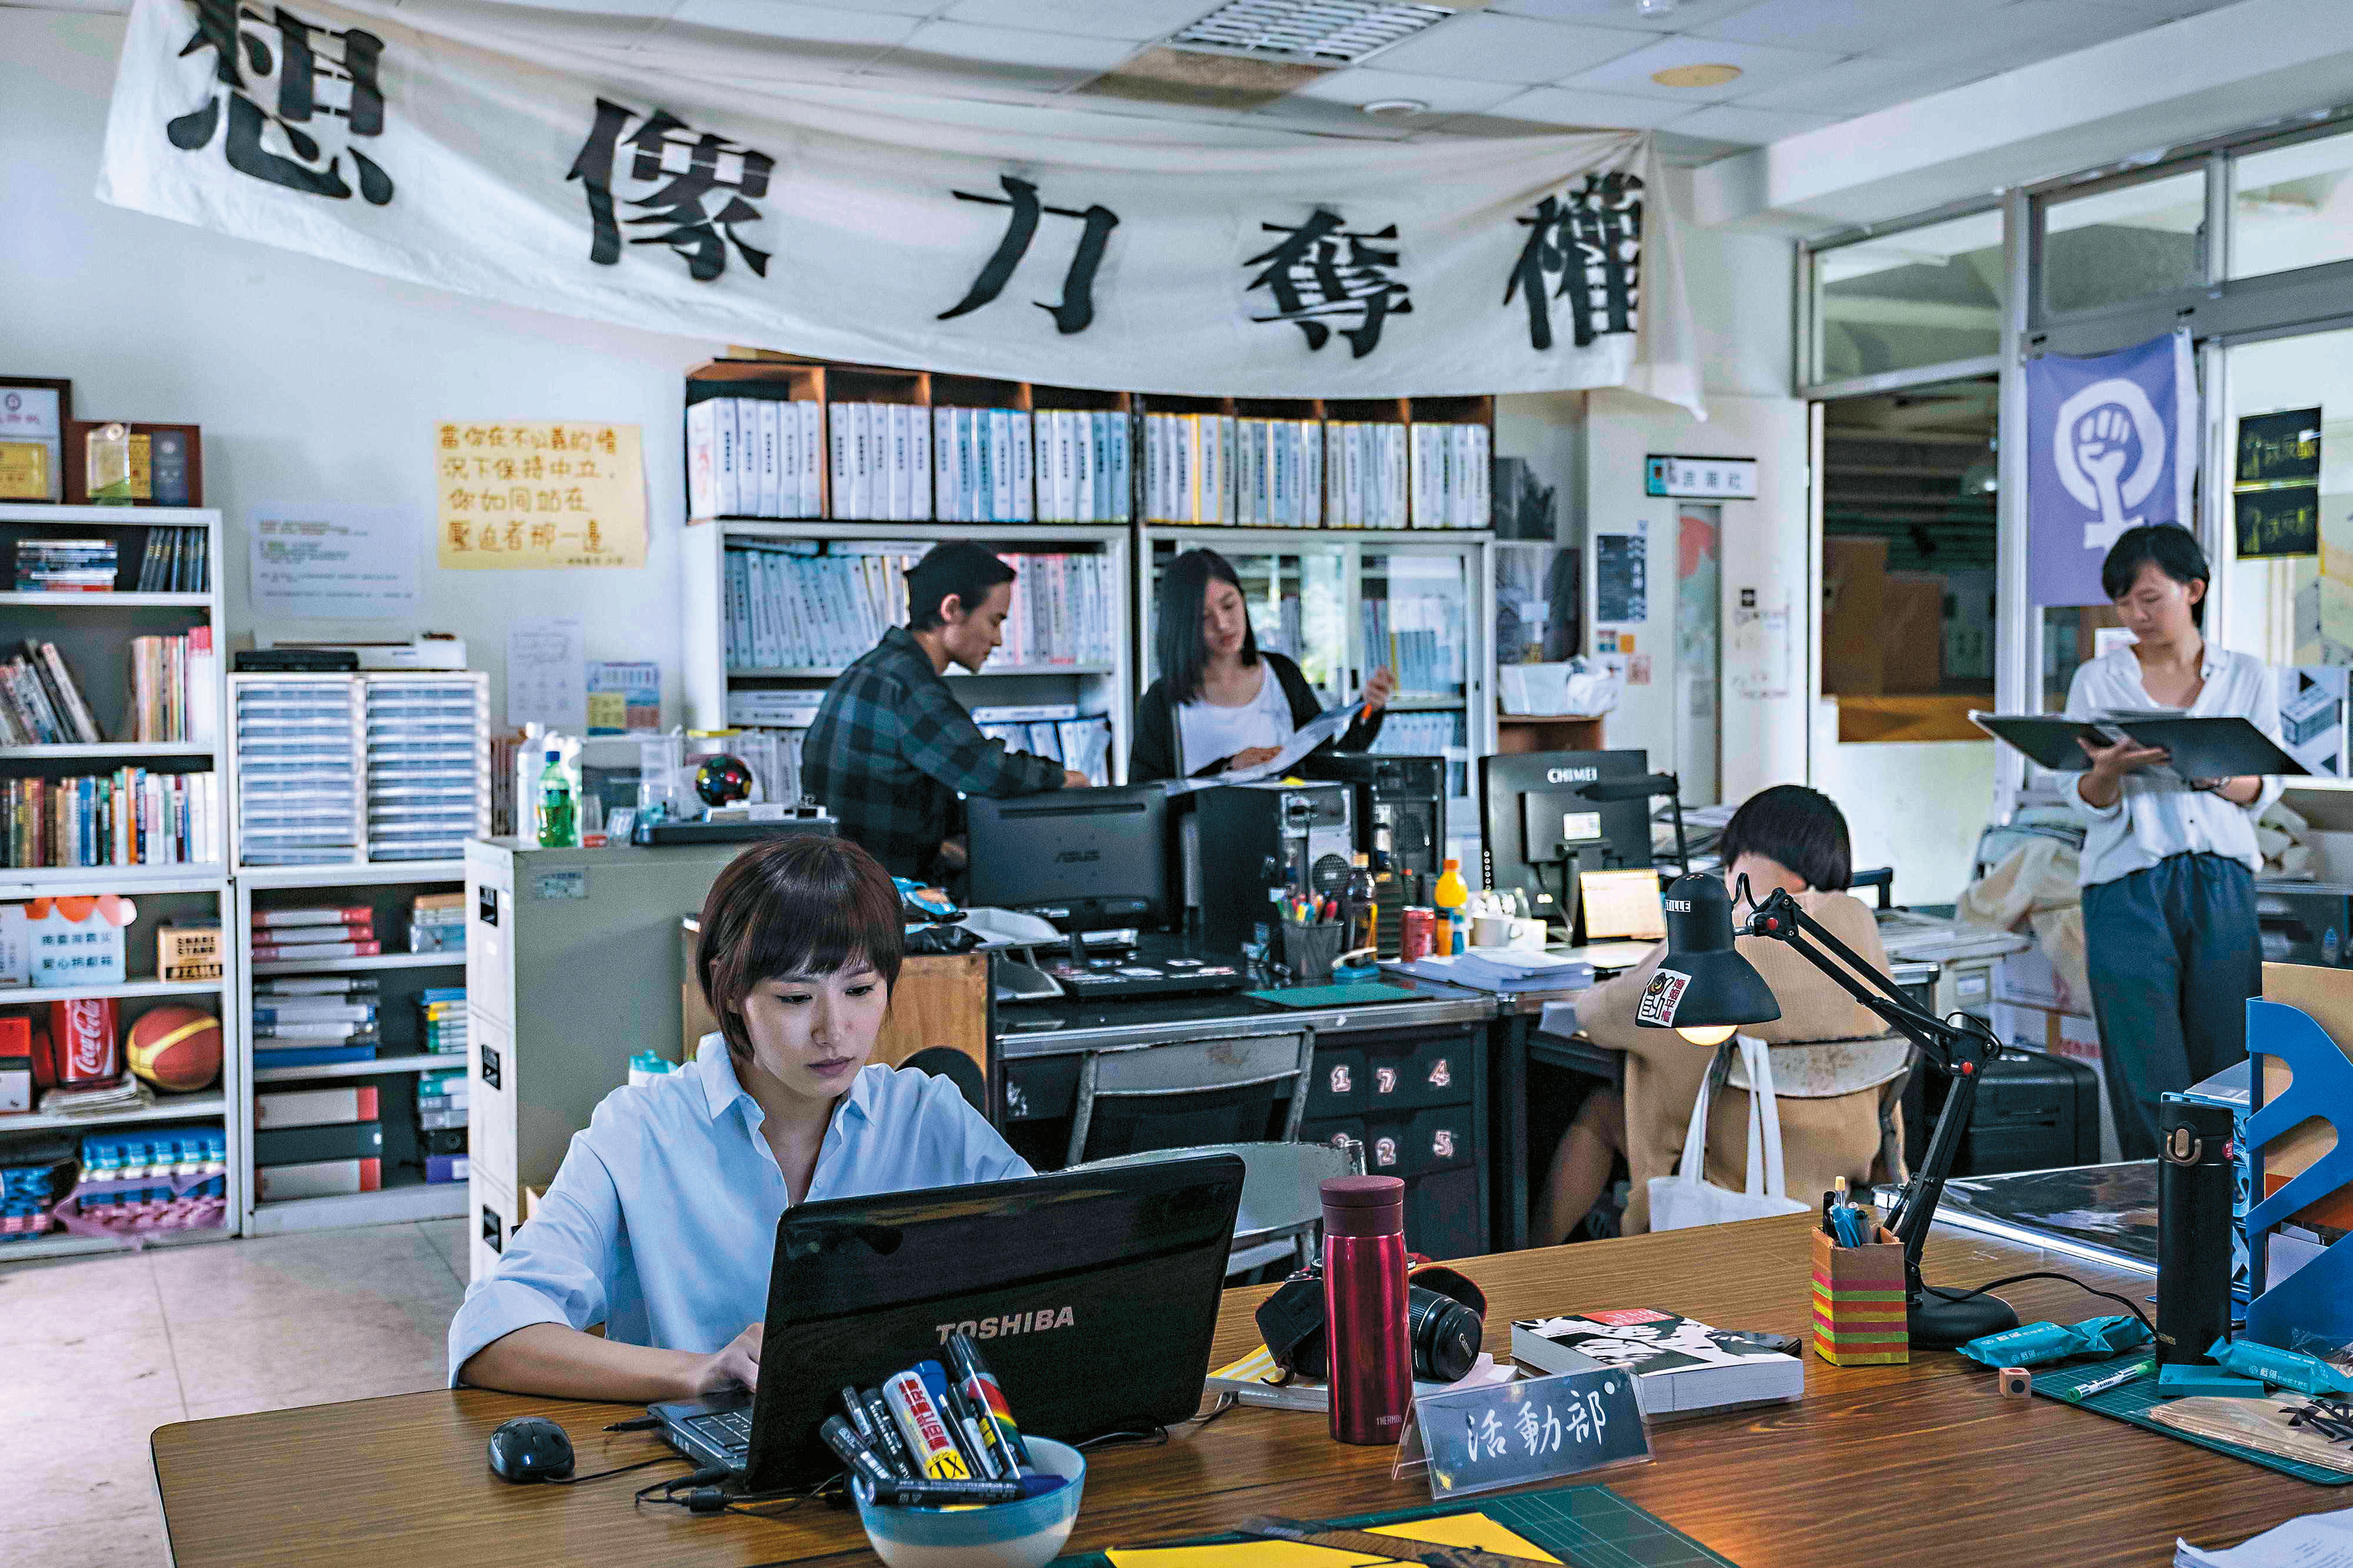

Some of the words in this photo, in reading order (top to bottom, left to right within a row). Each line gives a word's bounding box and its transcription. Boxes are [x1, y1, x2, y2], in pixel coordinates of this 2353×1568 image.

[1547, 767, 1598, 784] CHIMEI
[1331, 1065, 1351, 1092] 1
[1375, 1068, 1397, 1093] 7
[1429, 1059, 1451, 1086] 4
[1375, 1137, 1397, 1166] 2
[1433, 1130, 1454, 1156] 5
[936, 1306, 1075, 1346] TOSHIBA
[1459, 1333, 1473, 1358] Canon
[1376, 1415, 1402, 1426] THERMOS
[1467, 1390, 1606, 1462] 活動部
